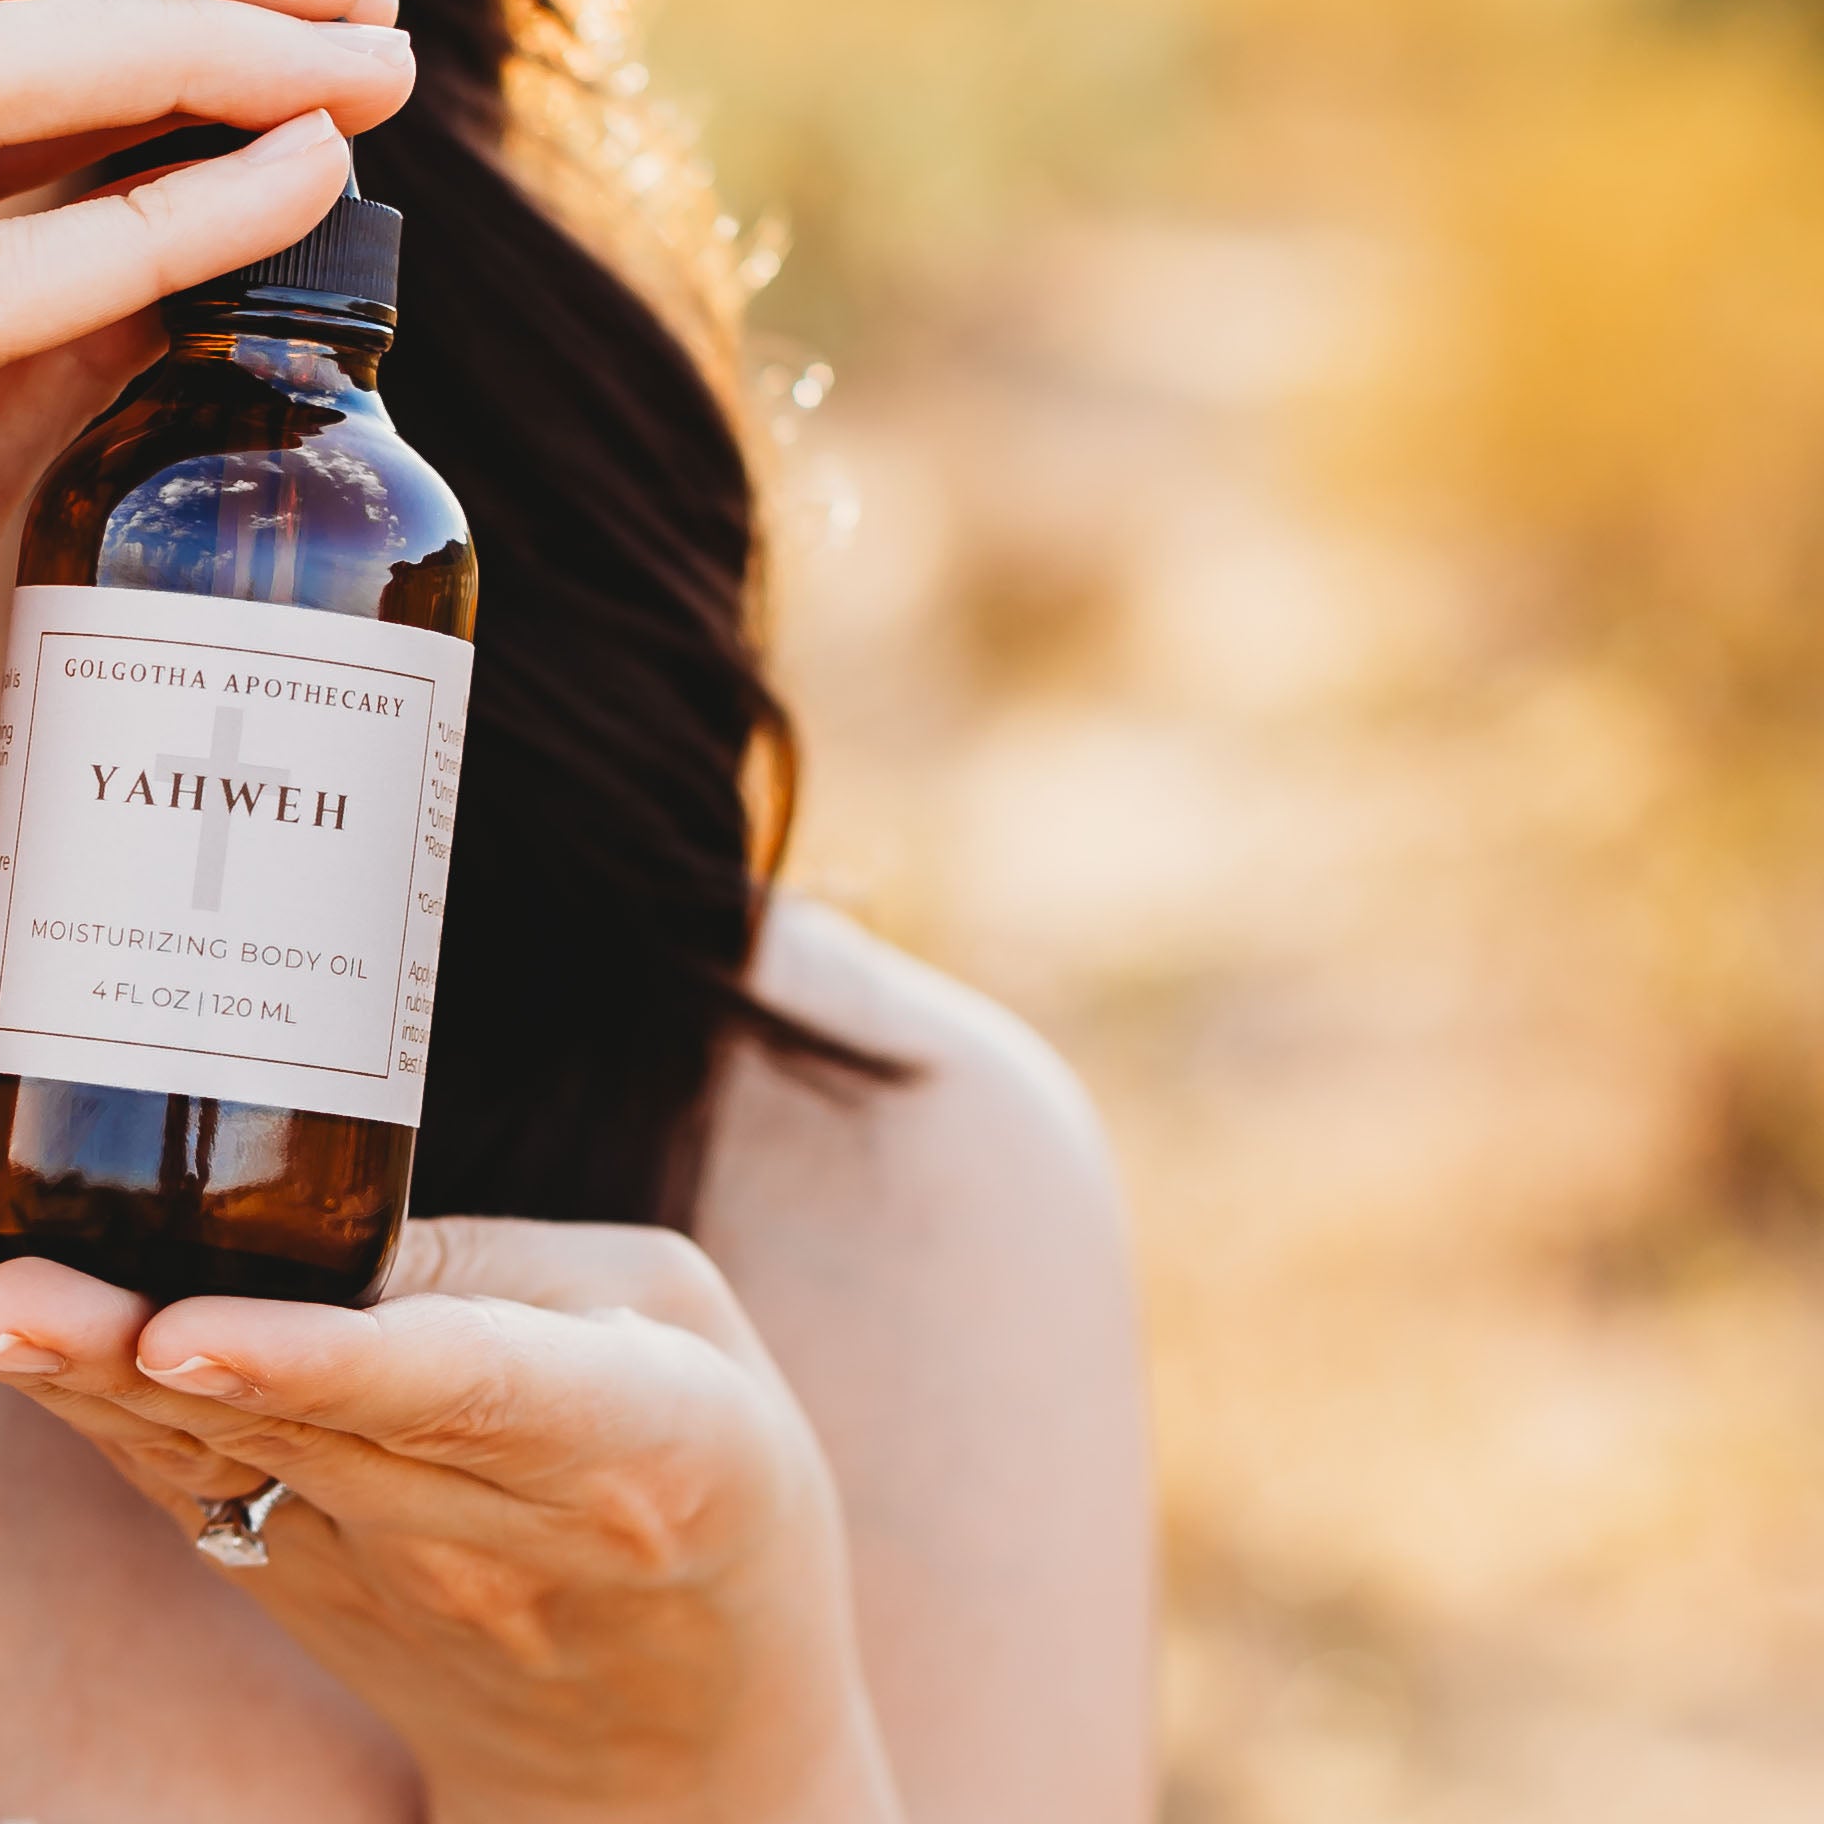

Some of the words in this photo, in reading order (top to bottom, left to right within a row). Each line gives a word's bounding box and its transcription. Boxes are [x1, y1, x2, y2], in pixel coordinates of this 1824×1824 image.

[64, 657, 207, 690] GOLGOTHA
[223, 673, 405, 718] APOTHECARY
[90, 763, 349, 831] YAHWEH
[31, 918, 227, 959] MOISTURIZING
[241, 942, 321, 971] BODY
[330, 955, 368, 979] OIL
[92, 981, 107, 1001] 4
[114, 982, 143, 1005] FL
[152, 987, 189, 1011] OZ
[213, 994, 252, 1018] 120
[261, 1000, 297, 1024] ML
